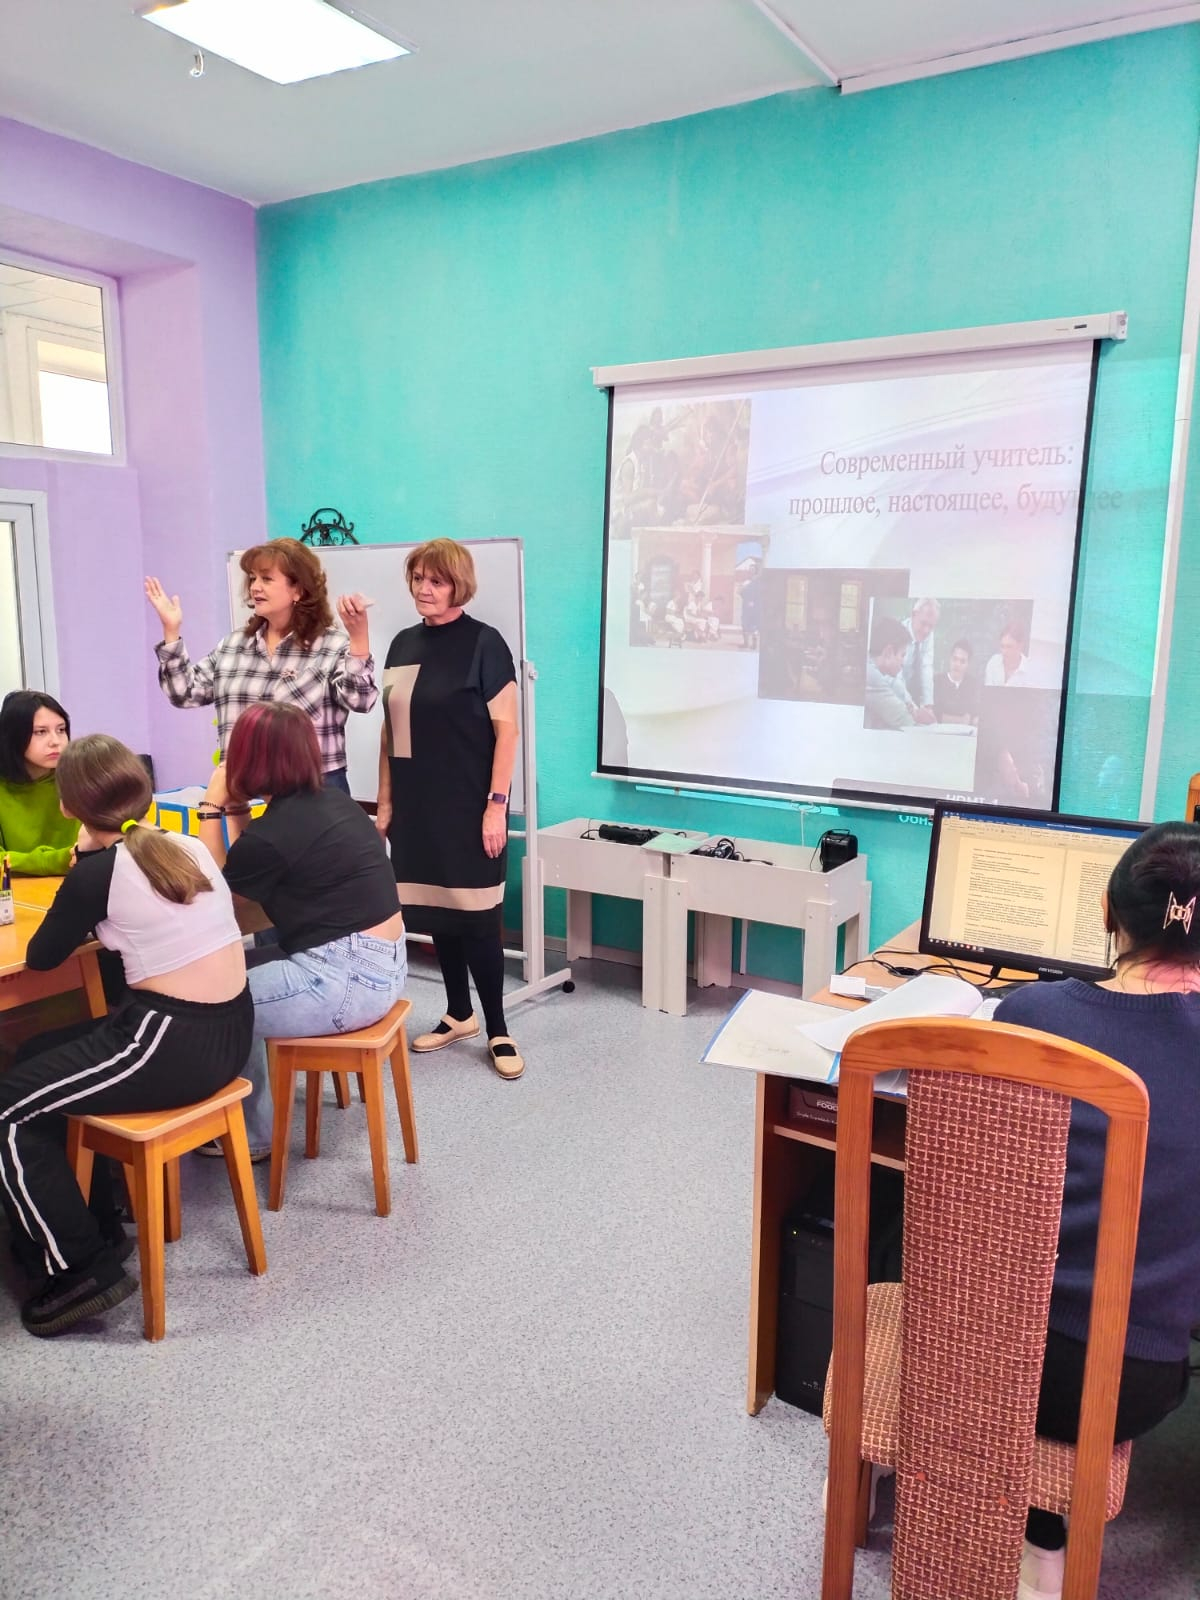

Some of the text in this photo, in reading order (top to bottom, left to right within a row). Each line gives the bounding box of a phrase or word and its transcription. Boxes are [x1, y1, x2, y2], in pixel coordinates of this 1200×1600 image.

[820, 443, 1074, 480] Современный учитель:
[788, 495, 881, 521] прошлое,
[888, 489, 1008, 515] настоящее,
